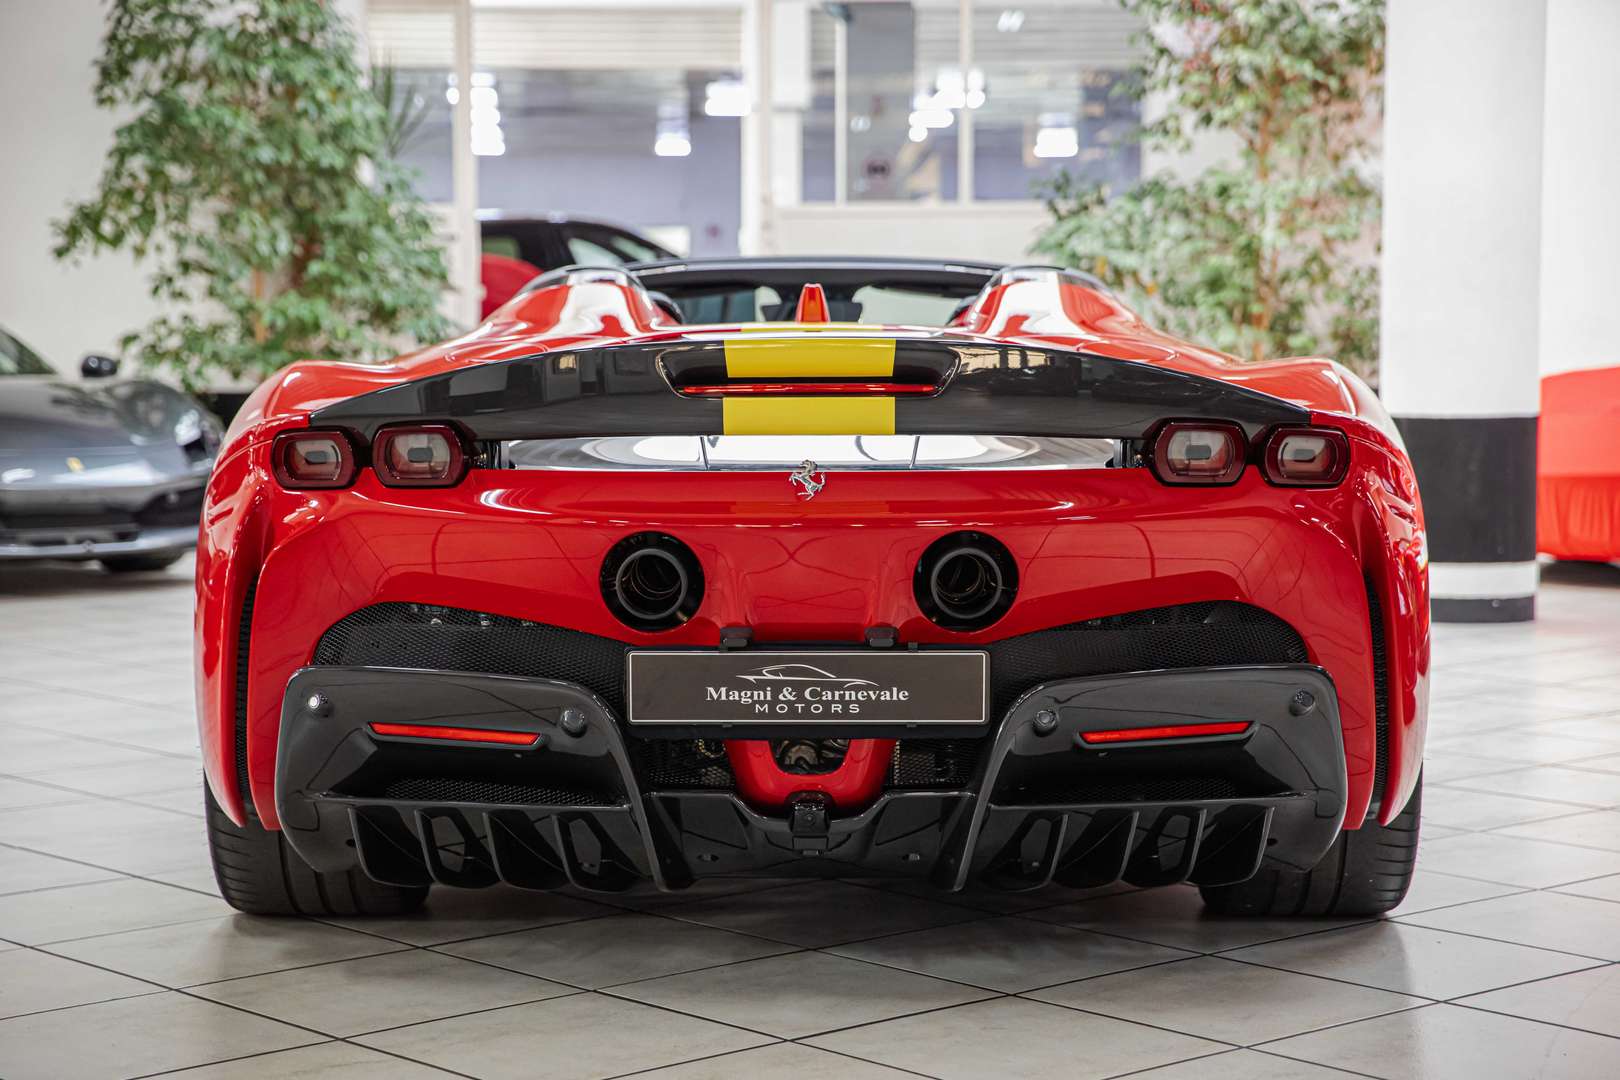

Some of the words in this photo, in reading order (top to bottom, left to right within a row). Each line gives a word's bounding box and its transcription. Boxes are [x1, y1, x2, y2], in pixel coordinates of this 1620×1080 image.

[705, 686, 772, 704] Magni
[778, 686, 798, 701] &
[804, 686, 909, 701] Carnevale
[755, 703, 860, 714] MOTORS
